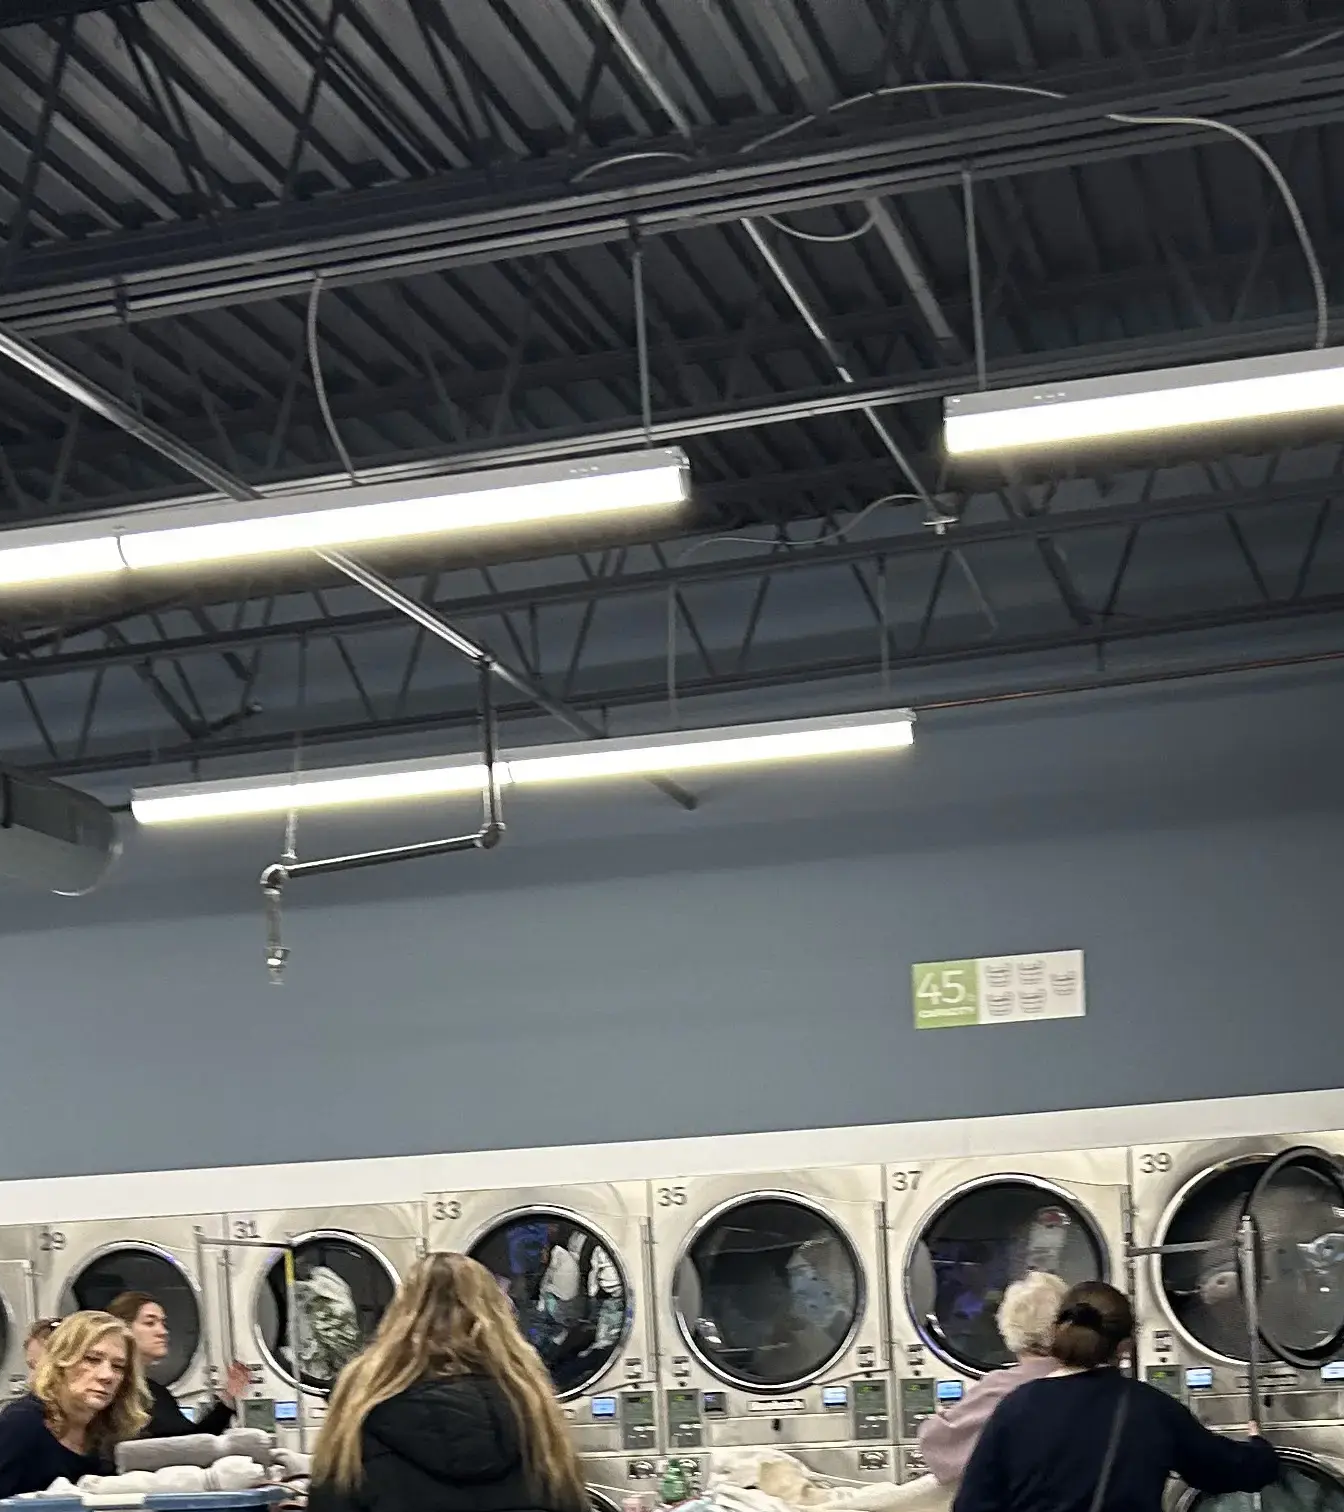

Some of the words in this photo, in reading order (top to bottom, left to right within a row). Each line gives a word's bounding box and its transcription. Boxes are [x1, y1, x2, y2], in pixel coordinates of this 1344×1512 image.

[916, 968, 966, 1006] 45
[1139, 1152, 1173, 1173] 39
[892, 1170, 923, 1192] 37
[656, 1186, 688, 1207] 35
[433, 1201, 462, 1221] 33
[233, 1219, 261, 1239] 31
[38, 1231, 67, 1252] 29
